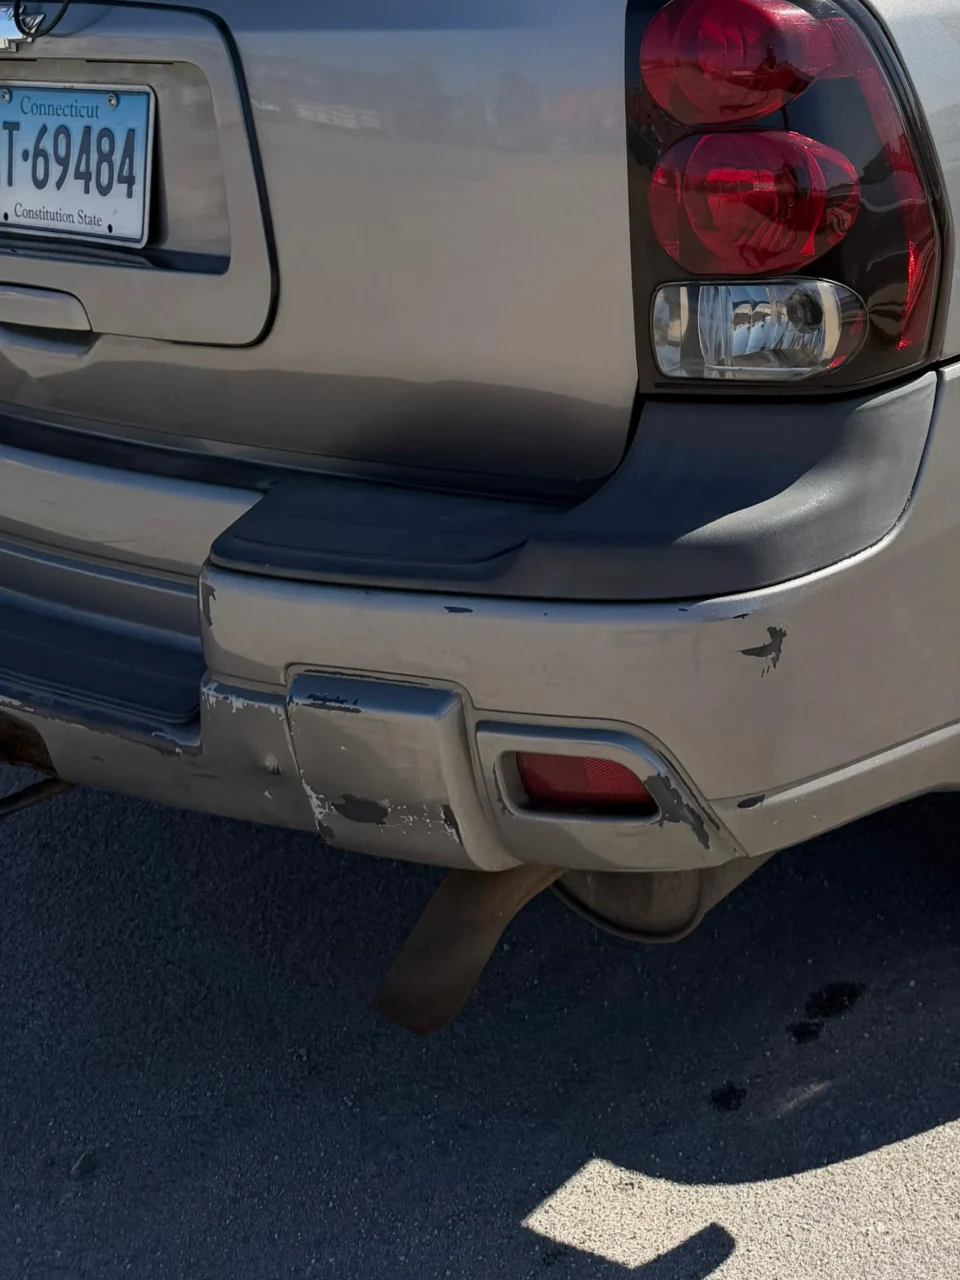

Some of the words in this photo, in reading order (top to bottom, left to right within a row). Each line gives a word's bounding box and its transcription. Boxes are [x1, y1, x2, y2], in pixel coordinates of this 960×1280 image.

[20, 95, 100, 119] Connecticut
[14, 202, 75, 224] Constitution
[77, 208, 103, 227] State
